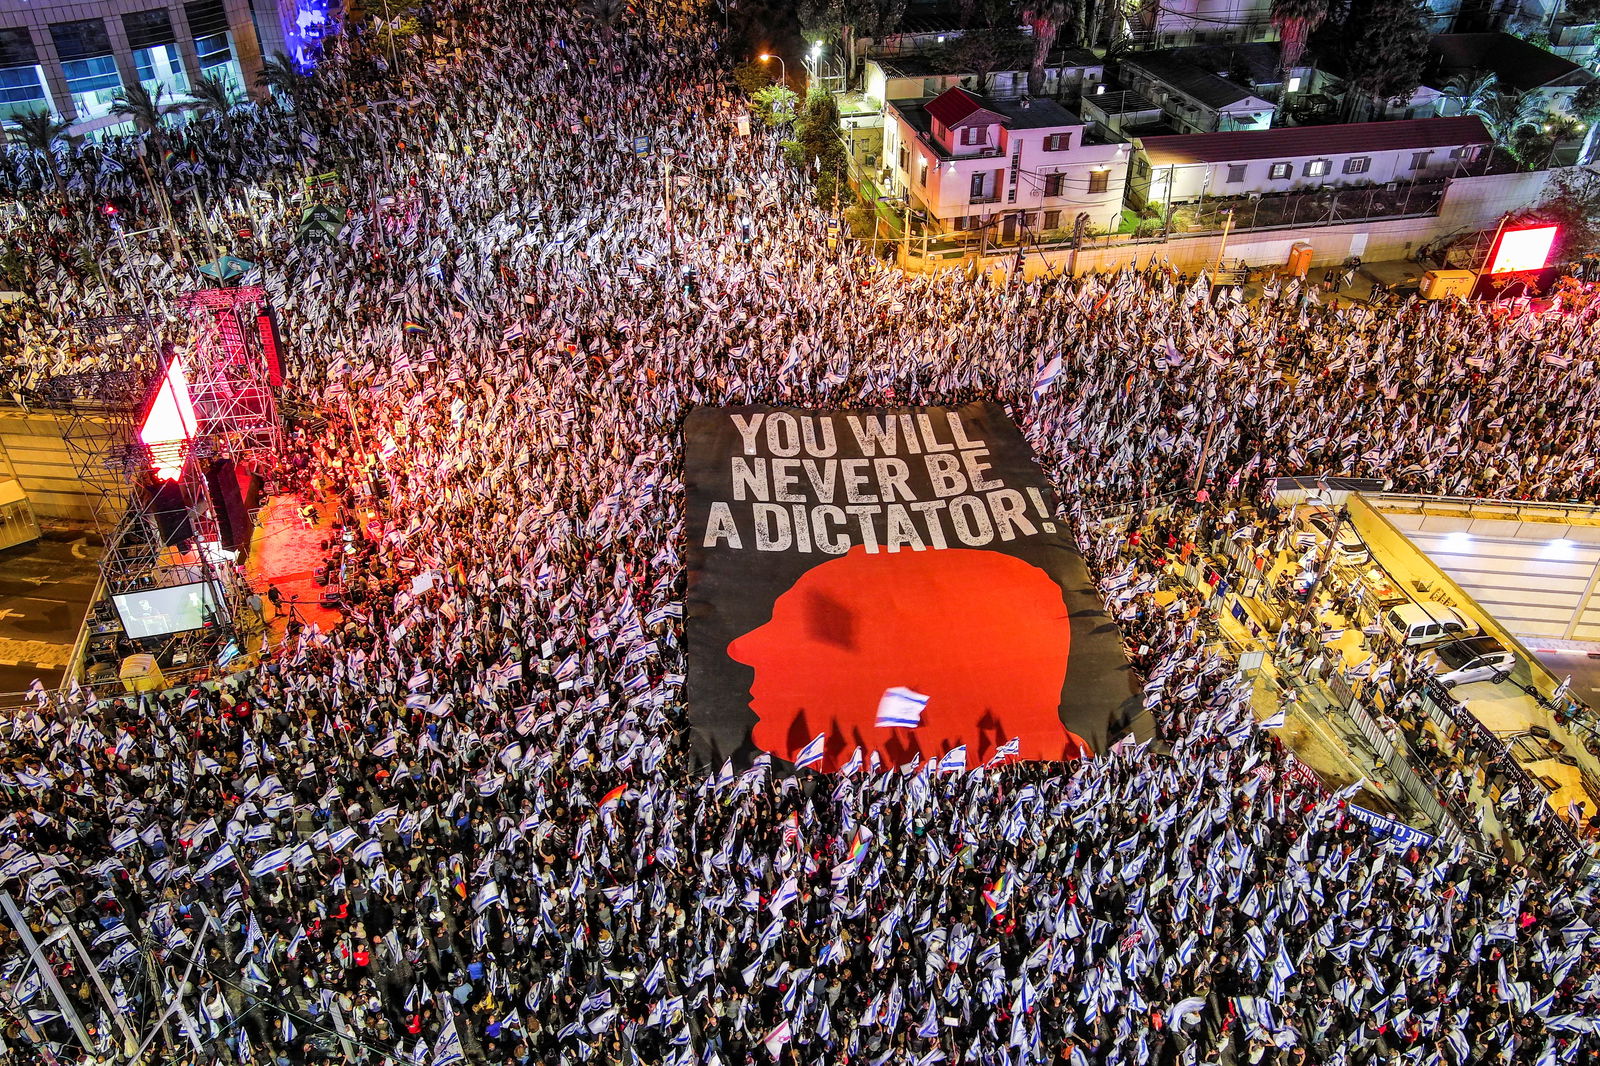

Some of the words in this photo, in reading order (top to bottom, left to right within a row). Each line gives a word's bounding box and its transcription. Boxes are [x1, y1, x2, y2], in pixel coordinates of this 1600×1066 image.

[730, 412, 838, 458] YOU
[846, 411, 986, 457] WILL
[731, 456, 917, 504] NEVER
[923, 448, 1005, 498] BE
[702, 501, 743, 550] A
[752, 486, 1057, 555] DICTATOR!
